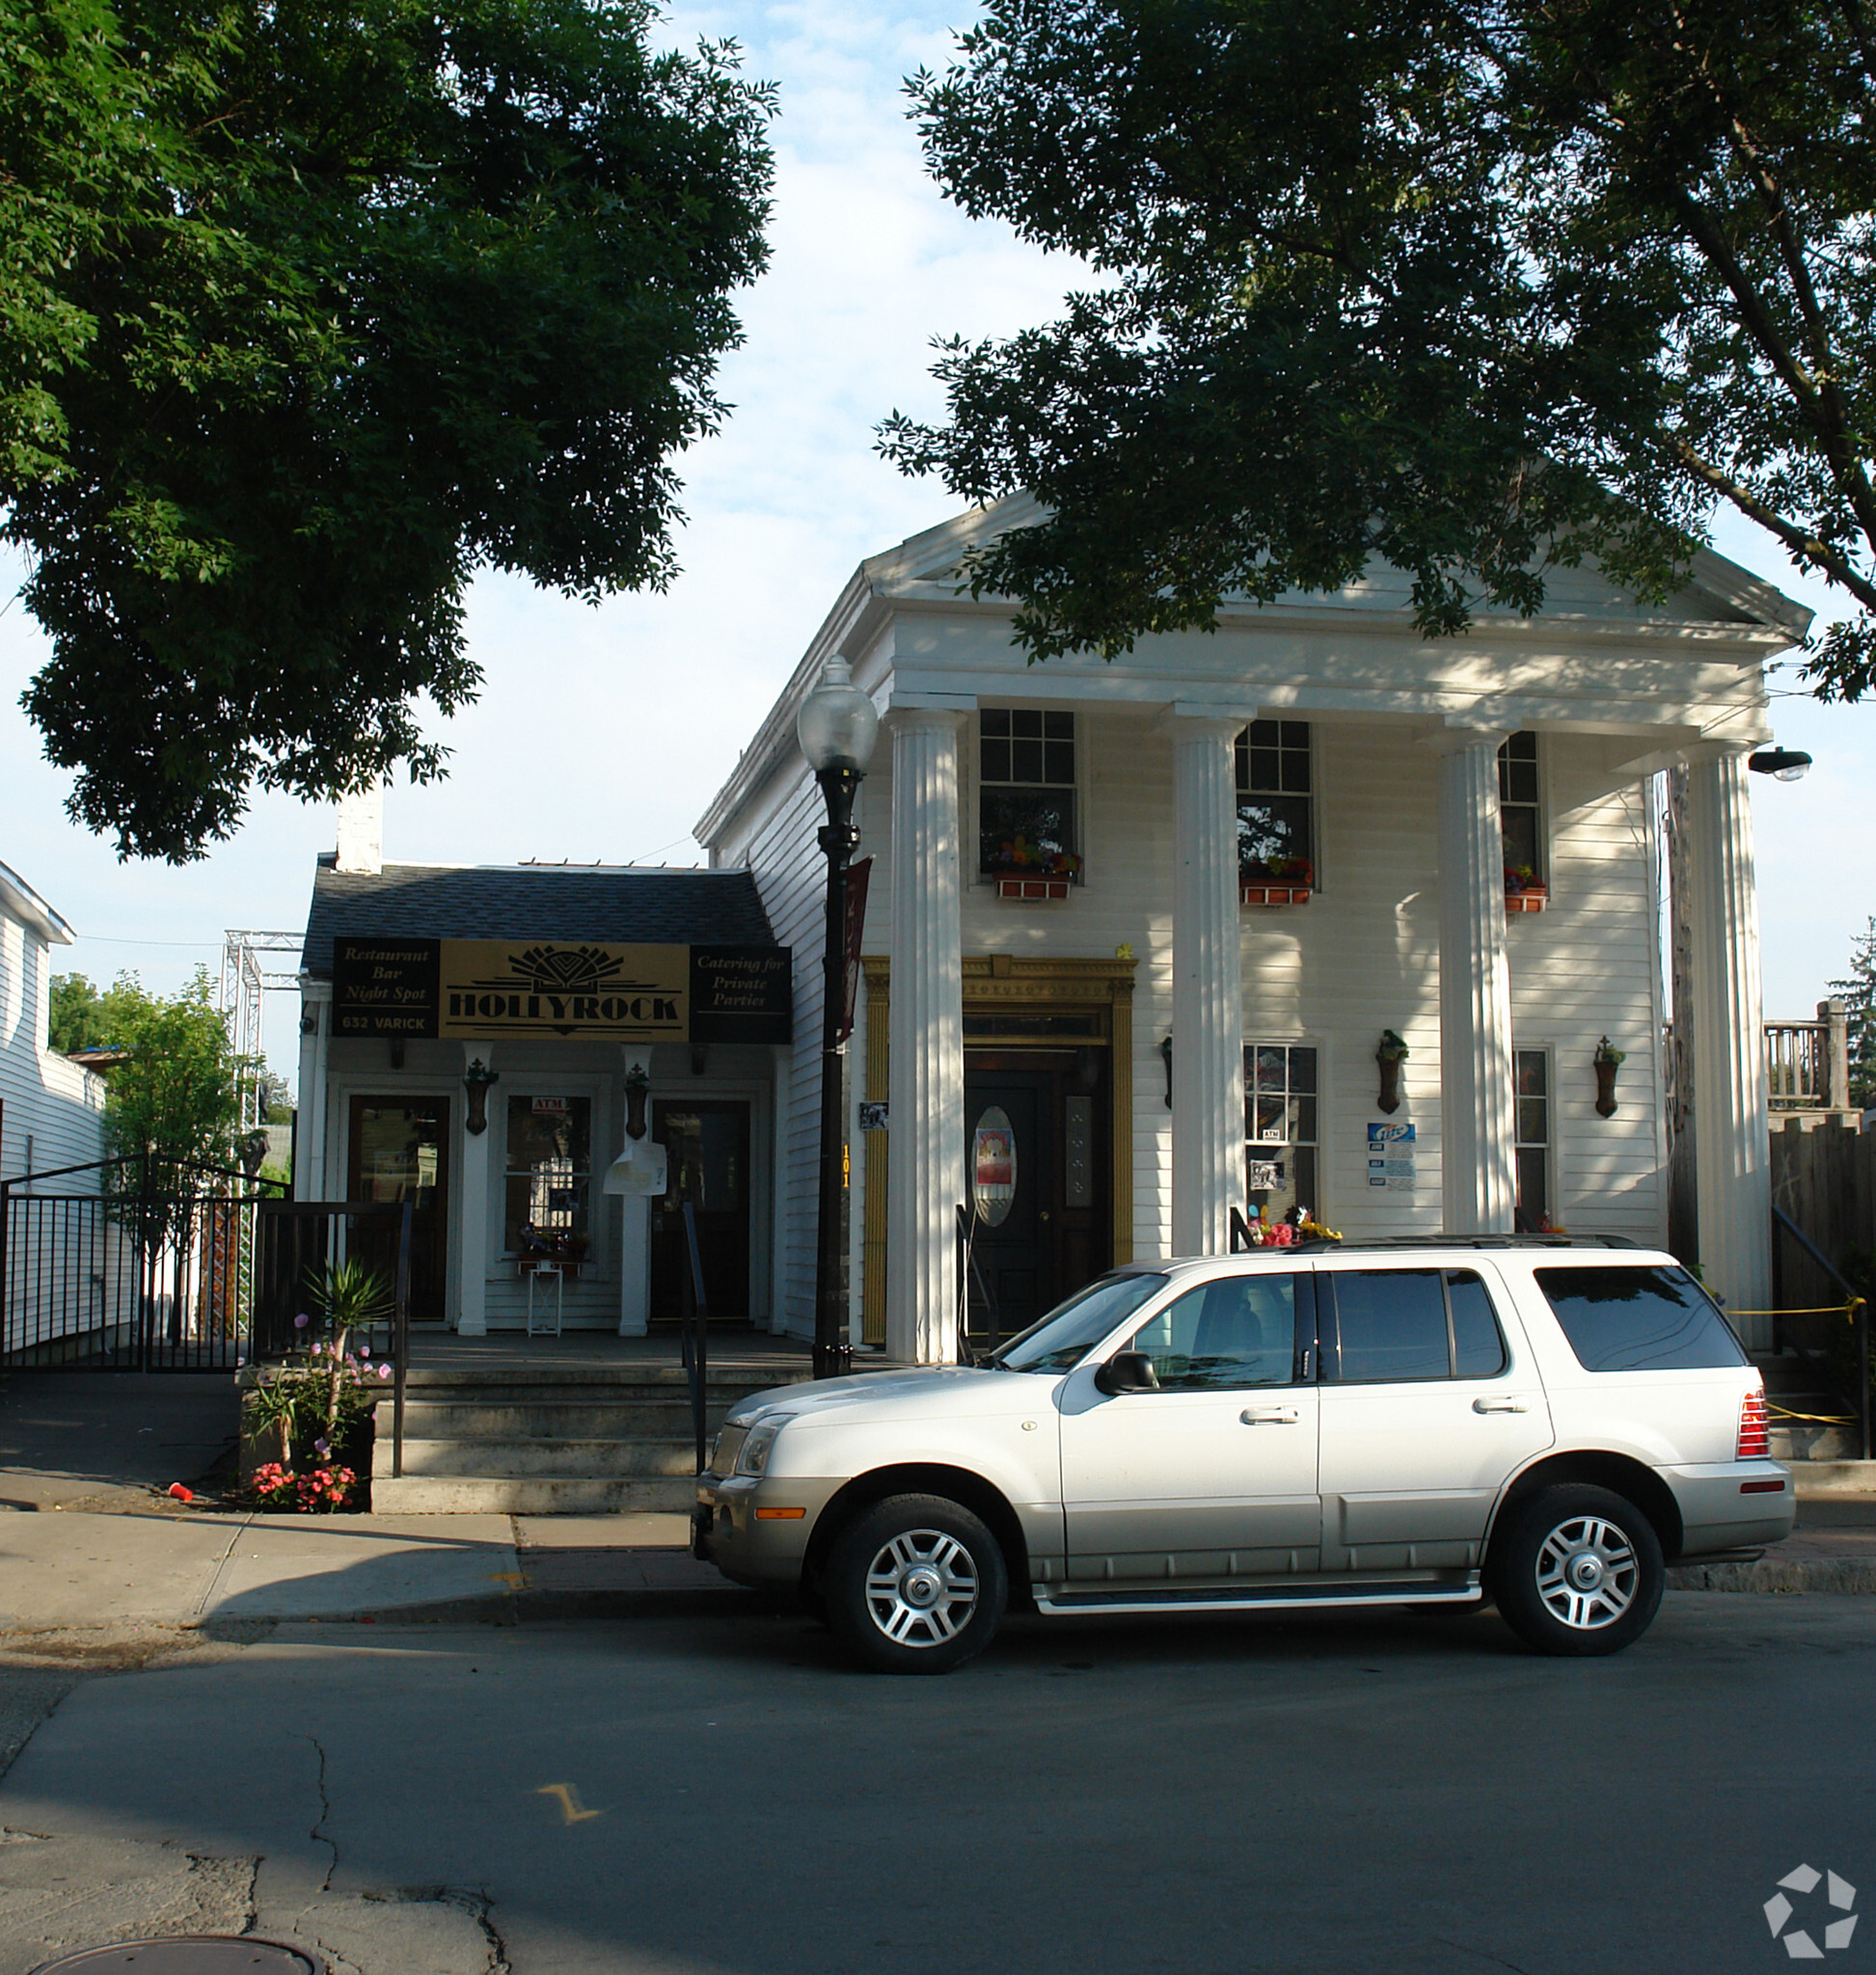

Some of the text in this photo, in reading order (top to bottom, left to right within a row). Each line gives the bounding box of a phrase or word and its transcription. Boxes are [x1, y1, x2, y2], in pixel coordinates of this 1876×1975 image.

[343, 947, 430, 962] Restaurant
[696, 955, 785, 973] Catering for
[370, 965, 403, 980] Bar
[712, 976, 768, 990] Private
[345, 985, 427, 1004] Night Spot
[712, 991, 768, 1006] Parties
[449, 993, 679, 1020] HOLLYROCK
[341, 1015, 426, 1031] 632 VARICK
[535, 1098, 563, 1108] ATM
